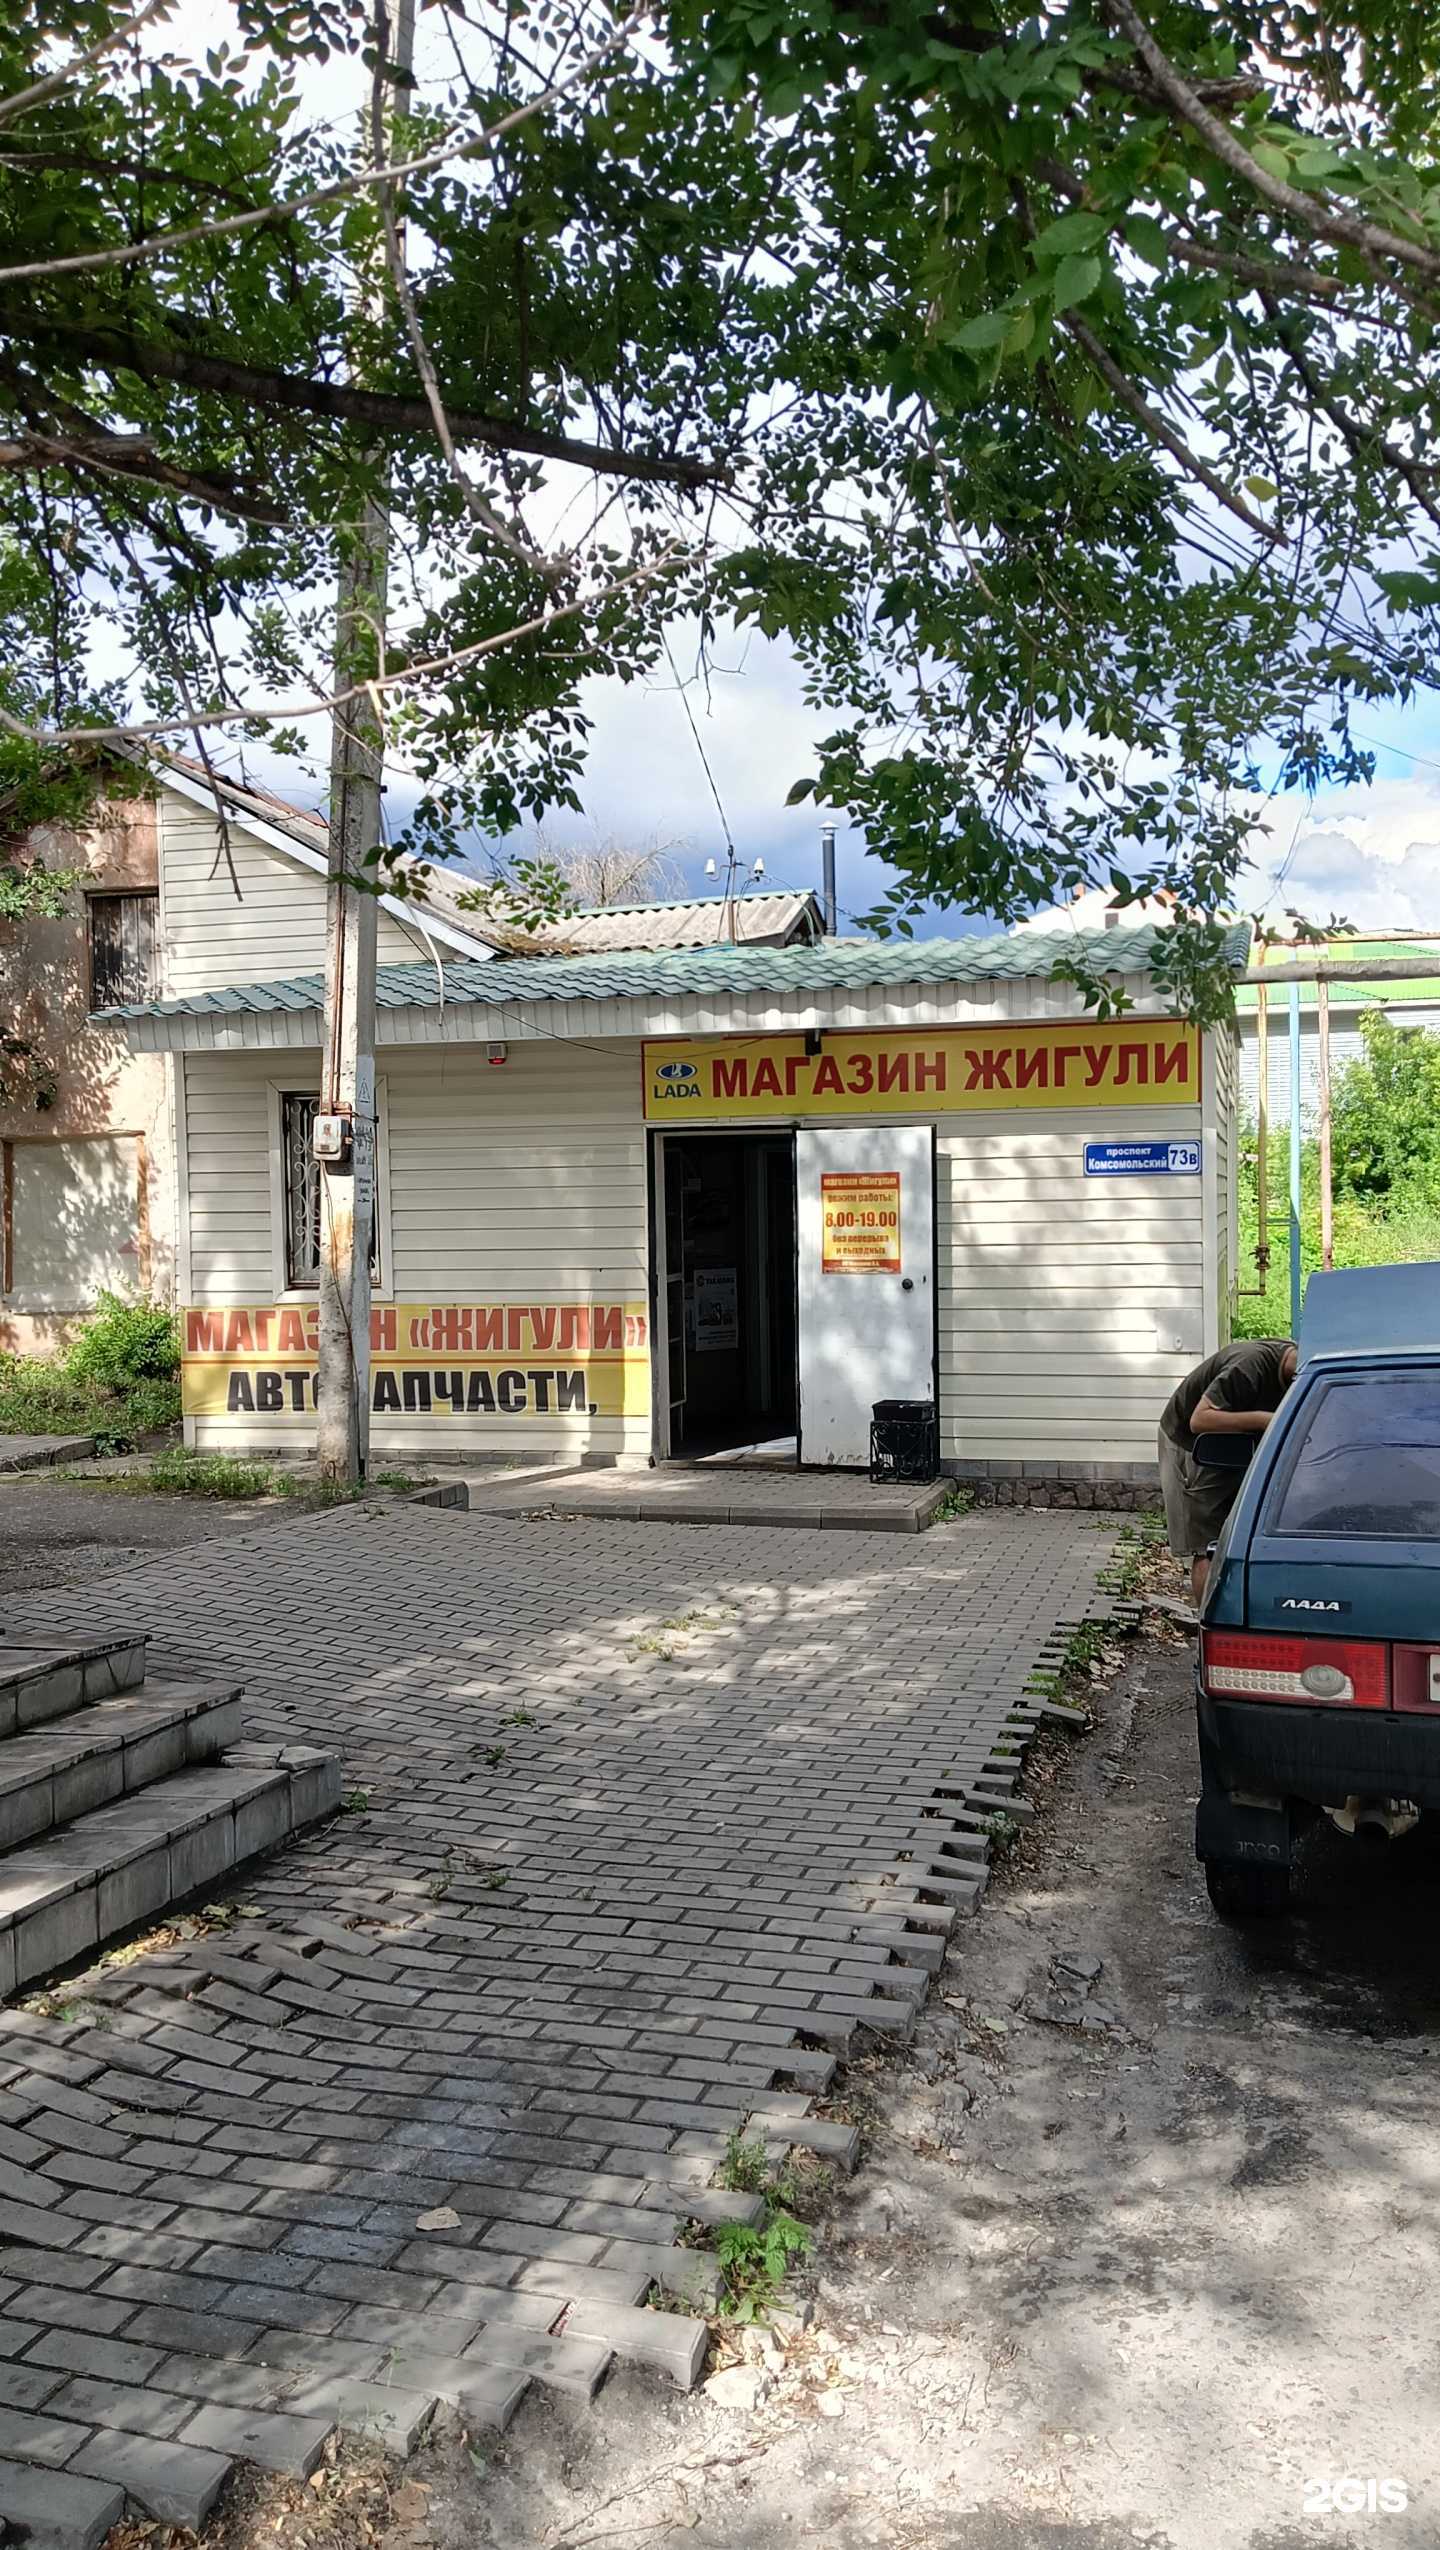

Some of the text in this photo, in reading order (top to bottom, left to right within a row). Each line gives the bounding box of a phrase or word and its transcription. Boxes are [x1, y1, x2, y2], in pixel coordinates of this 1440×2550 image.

[712, 1041, 1189, 1098] МАГАЗИН ЖИГУЛИ
[653, 1083, 702, 1099] LADA
[1106, 1147, 1152, 1158] проспект
[1088, 1156, 1168, 1171] Комсомольский
[825, 1211, 897, 1228] 8.00-19.00
[186, 1307, 647, 1352] МАГАН «ЖИГУЛИ»
[1281, 1598, 1341, 1612] ЛАДА
